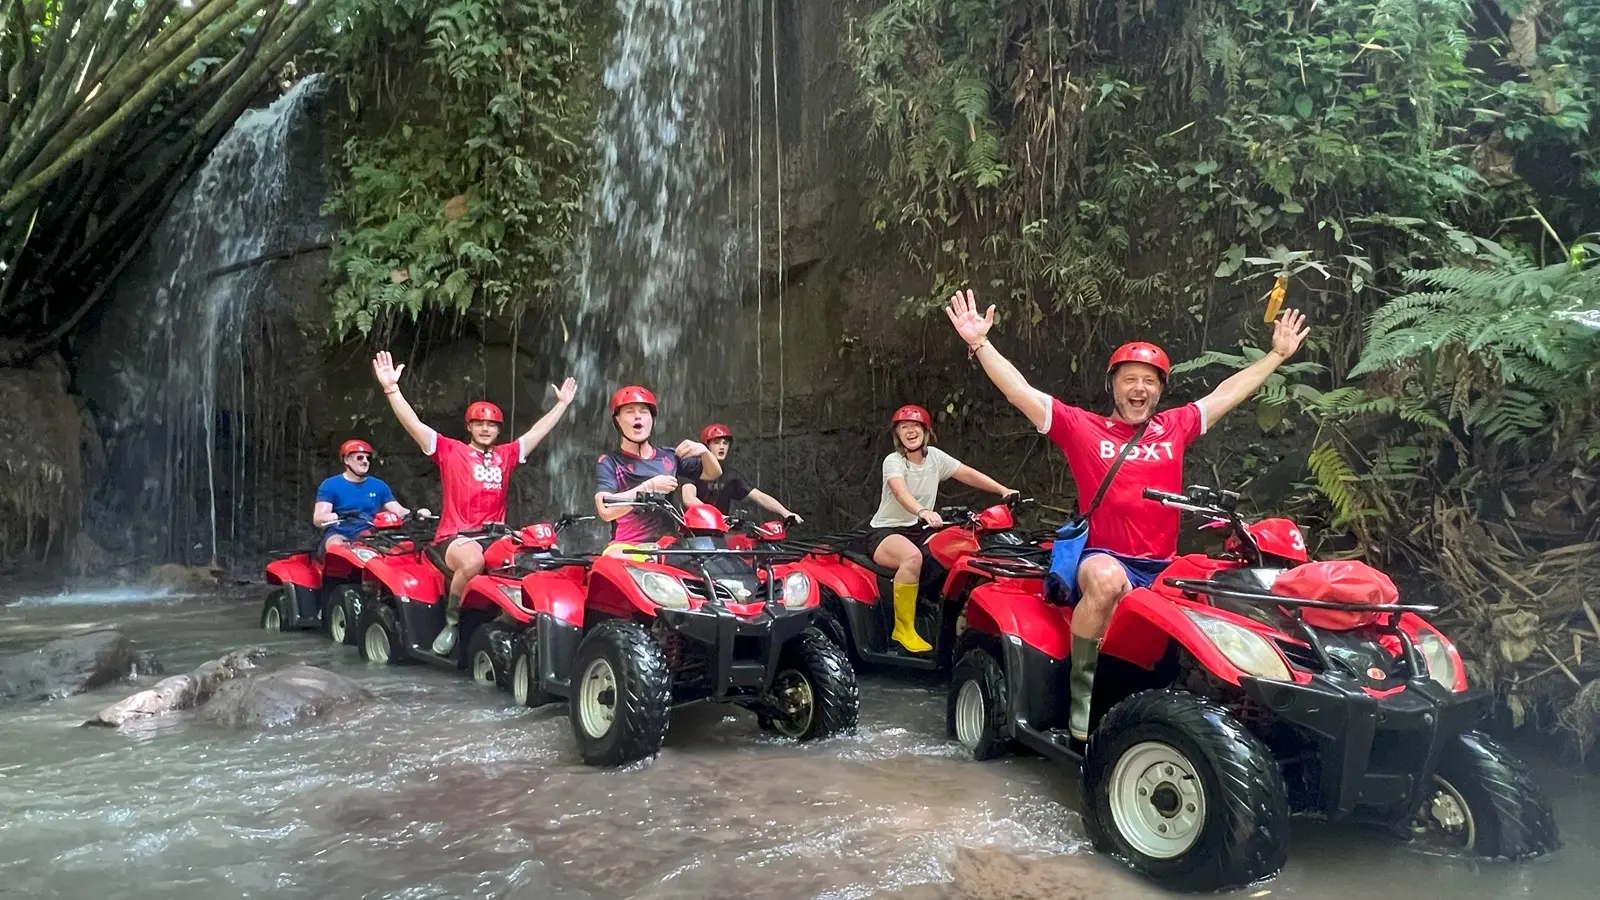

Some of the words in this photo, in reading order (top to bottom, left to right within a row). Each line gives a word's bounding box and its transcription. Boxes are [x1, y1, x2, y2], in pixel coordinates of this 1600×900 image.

[1100, 440, 1173, 460] BOXT
[473, 463, 503, 483] 888
[483, 482, 503, 490] sport
[536, 525, 552, 539] 30
